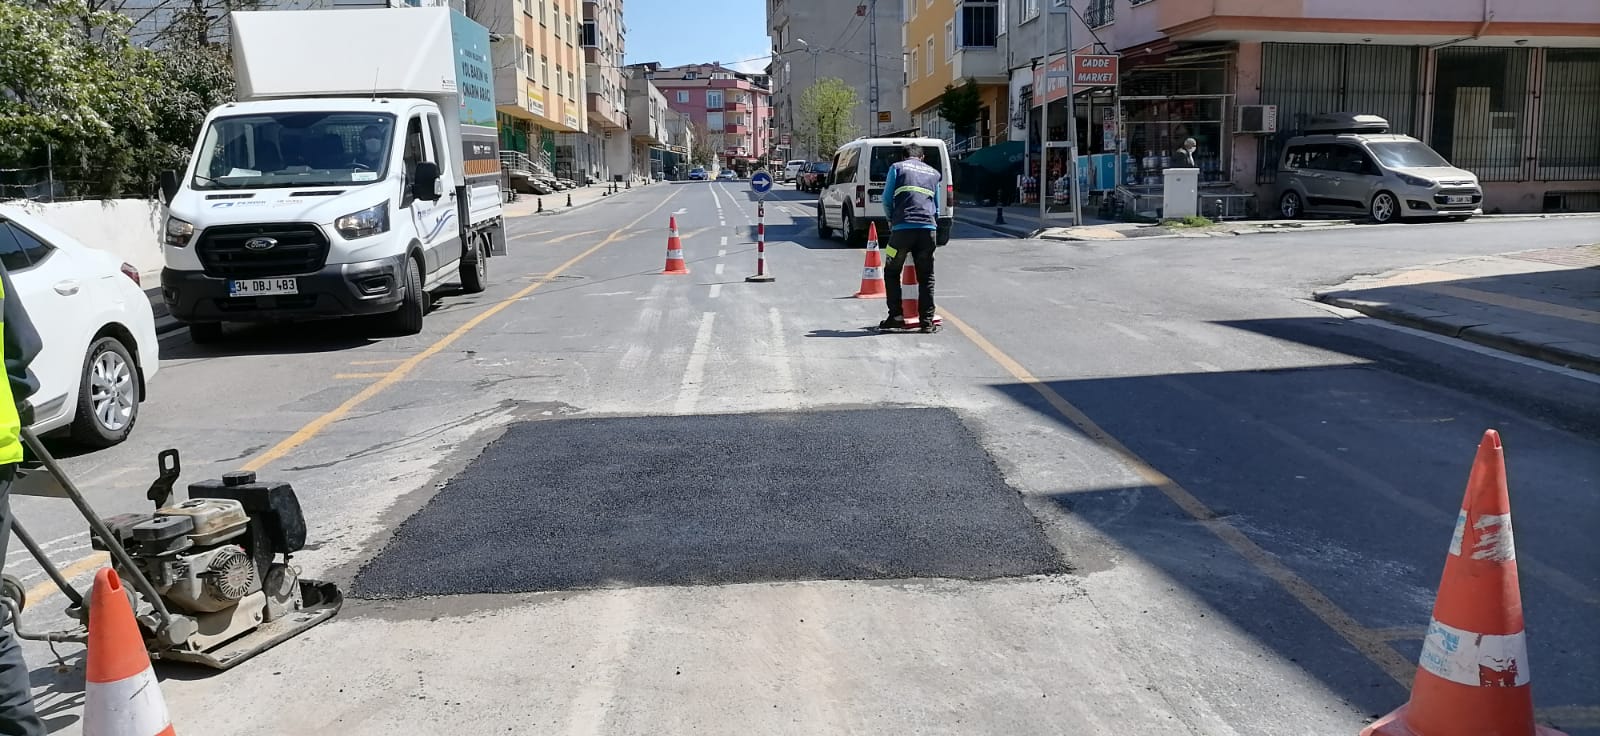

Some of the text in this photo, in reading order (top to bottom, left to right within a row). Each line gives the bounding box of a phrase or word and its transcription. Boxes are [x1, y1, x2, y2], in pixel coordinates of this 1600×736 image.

[1082, 58, 1110, 68] CADDE
[462, 61, 471, 78] YOL
[470, 63, 484, 81] BAKIM
[1078, 72, 1113, 82] MARKET
[462, 81, 480, 99] ONARIM
[479, 86, 491, 102] ARACI
[250, 240, 268, 248] Ford
[236, 279, 295, 292] 34 DBJ 483
